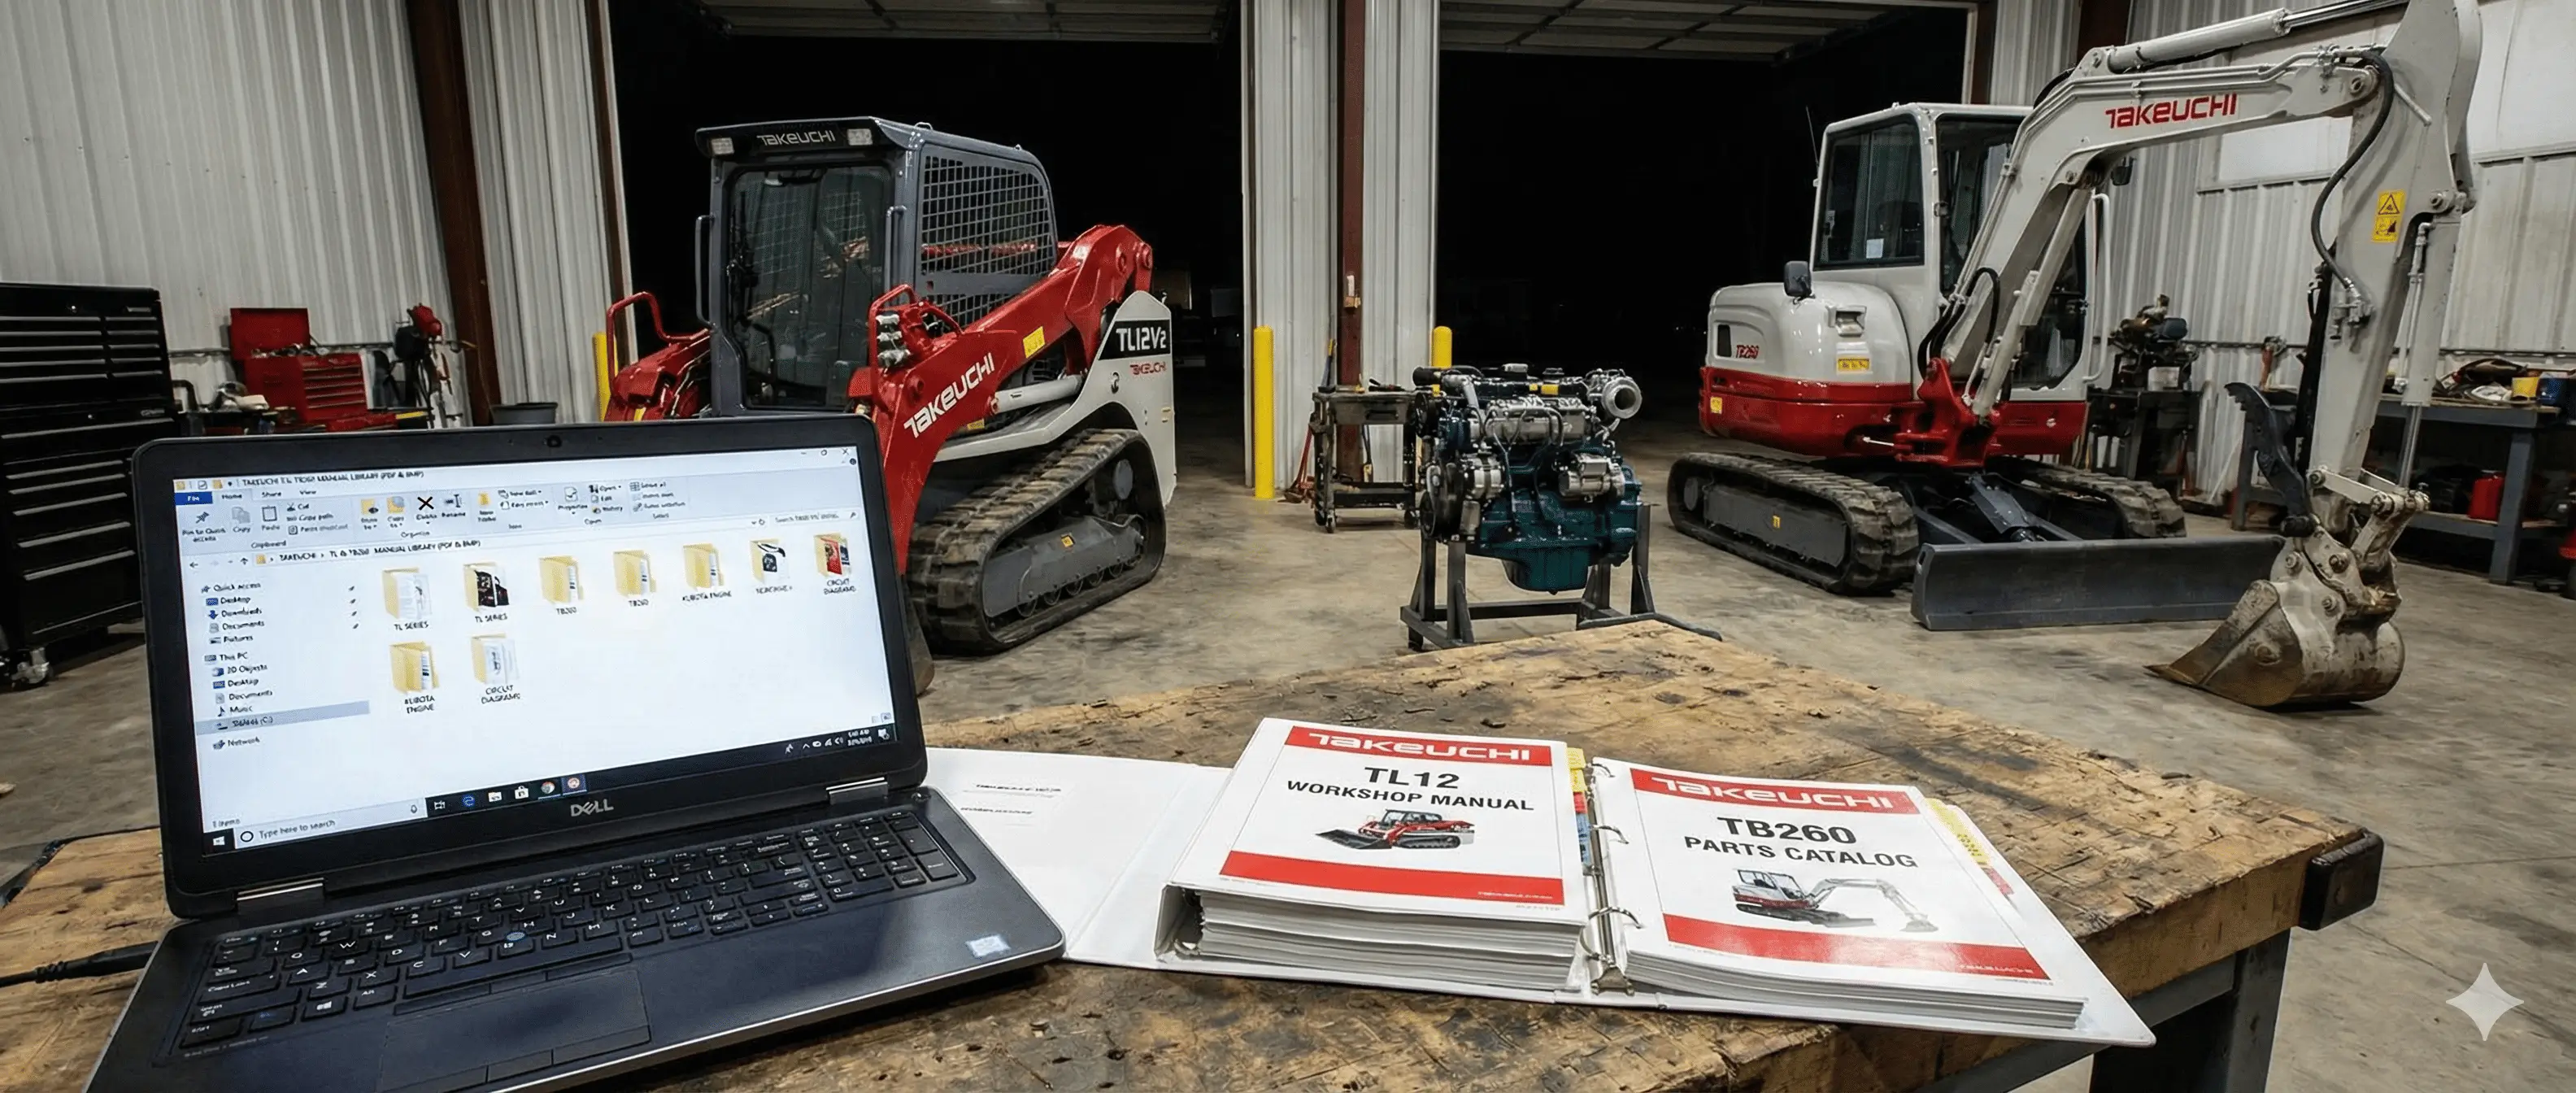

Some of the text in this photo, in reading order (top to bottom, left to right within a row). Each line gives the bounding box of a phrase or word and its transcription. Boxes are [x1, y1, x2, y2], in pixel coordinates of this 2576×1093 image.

[1364, 767, 1460, 790] TL12
[570, 799, 614, 817] DELL
[1287, 781, 1534, 811] WORKSHOP MANUAL
[259, 830, 278, 840] Type
[280, 825, 298, 834] here
[299, 823, 309, 832] to
[1717, 816, 1857, 845] TB260
[1684, 836, 1919, 868] PARTS CATALOG
